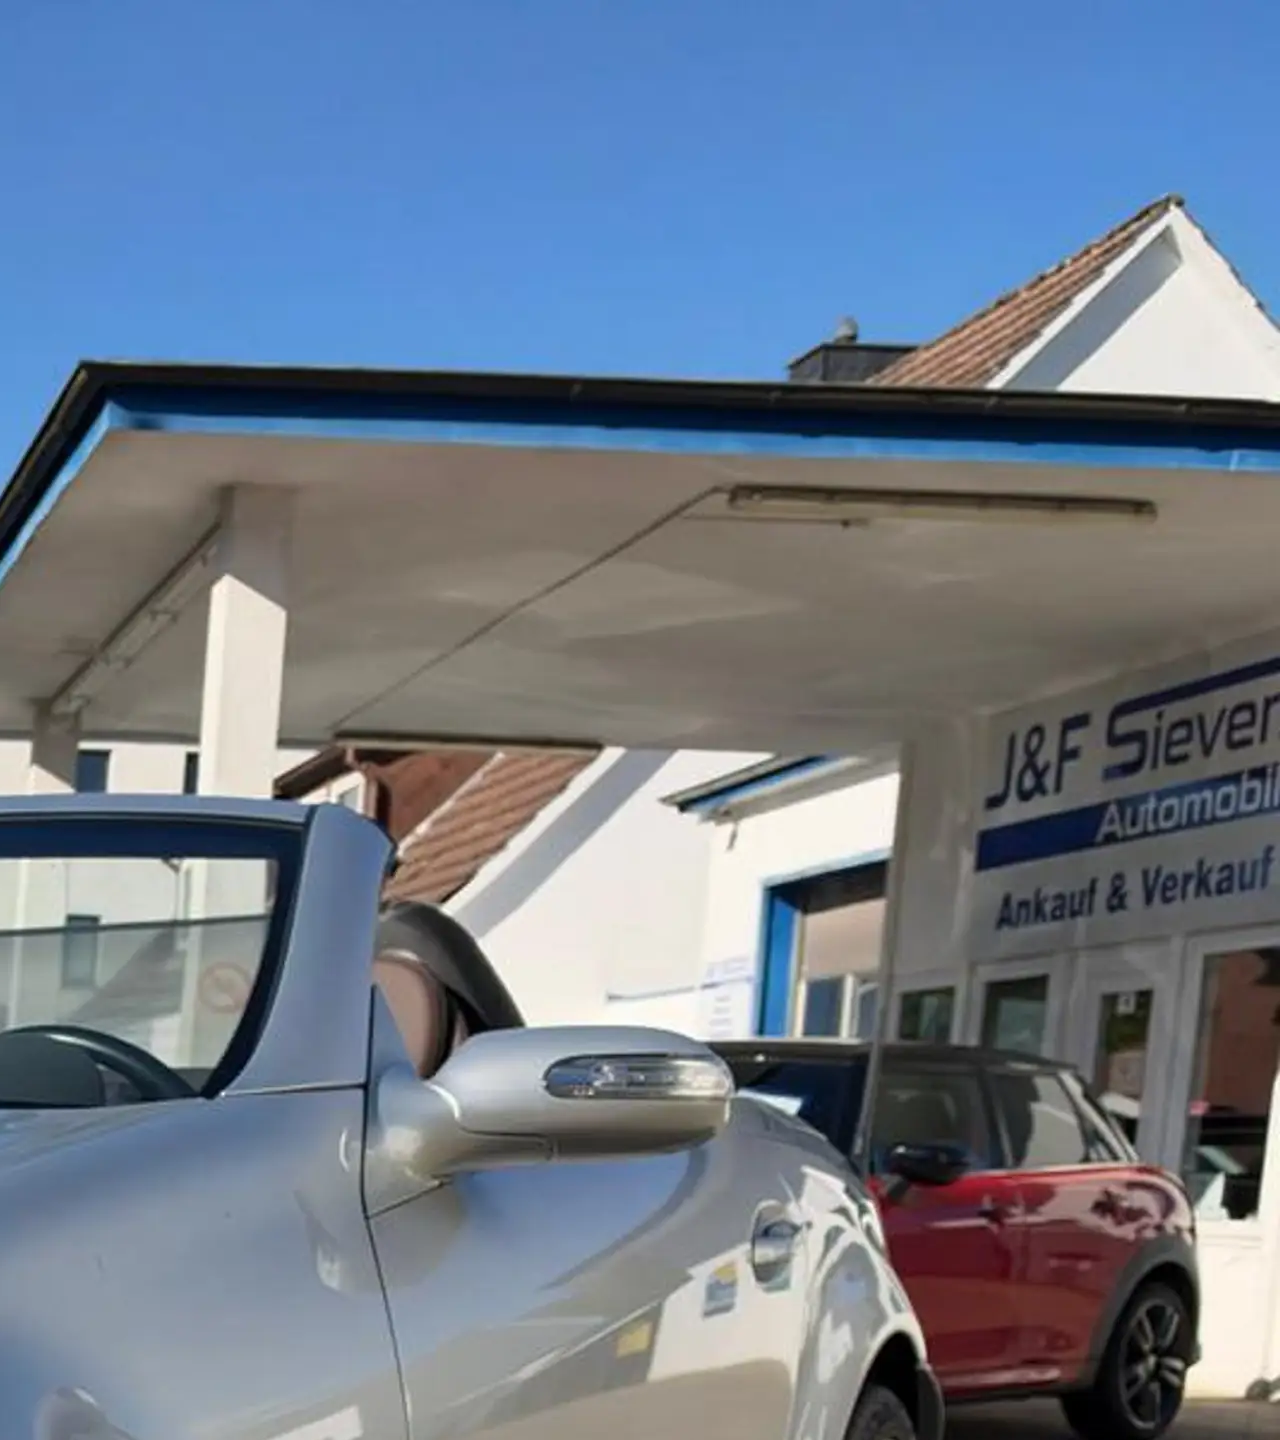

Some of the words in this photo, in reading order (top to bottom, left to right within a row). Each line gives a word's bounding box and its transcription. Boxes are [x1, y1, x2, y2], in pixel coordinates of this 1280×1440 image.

[984, 711, 1092, 811] J&F
[1101, 682, 1280, 783] Siever
[1093, 762, 1280, 845] Automobil
[995, 877, 1098, 931] Ankauf
[1106, 871, 1129, 914] &
[1142, 845, 1276, 908] Verkauf
